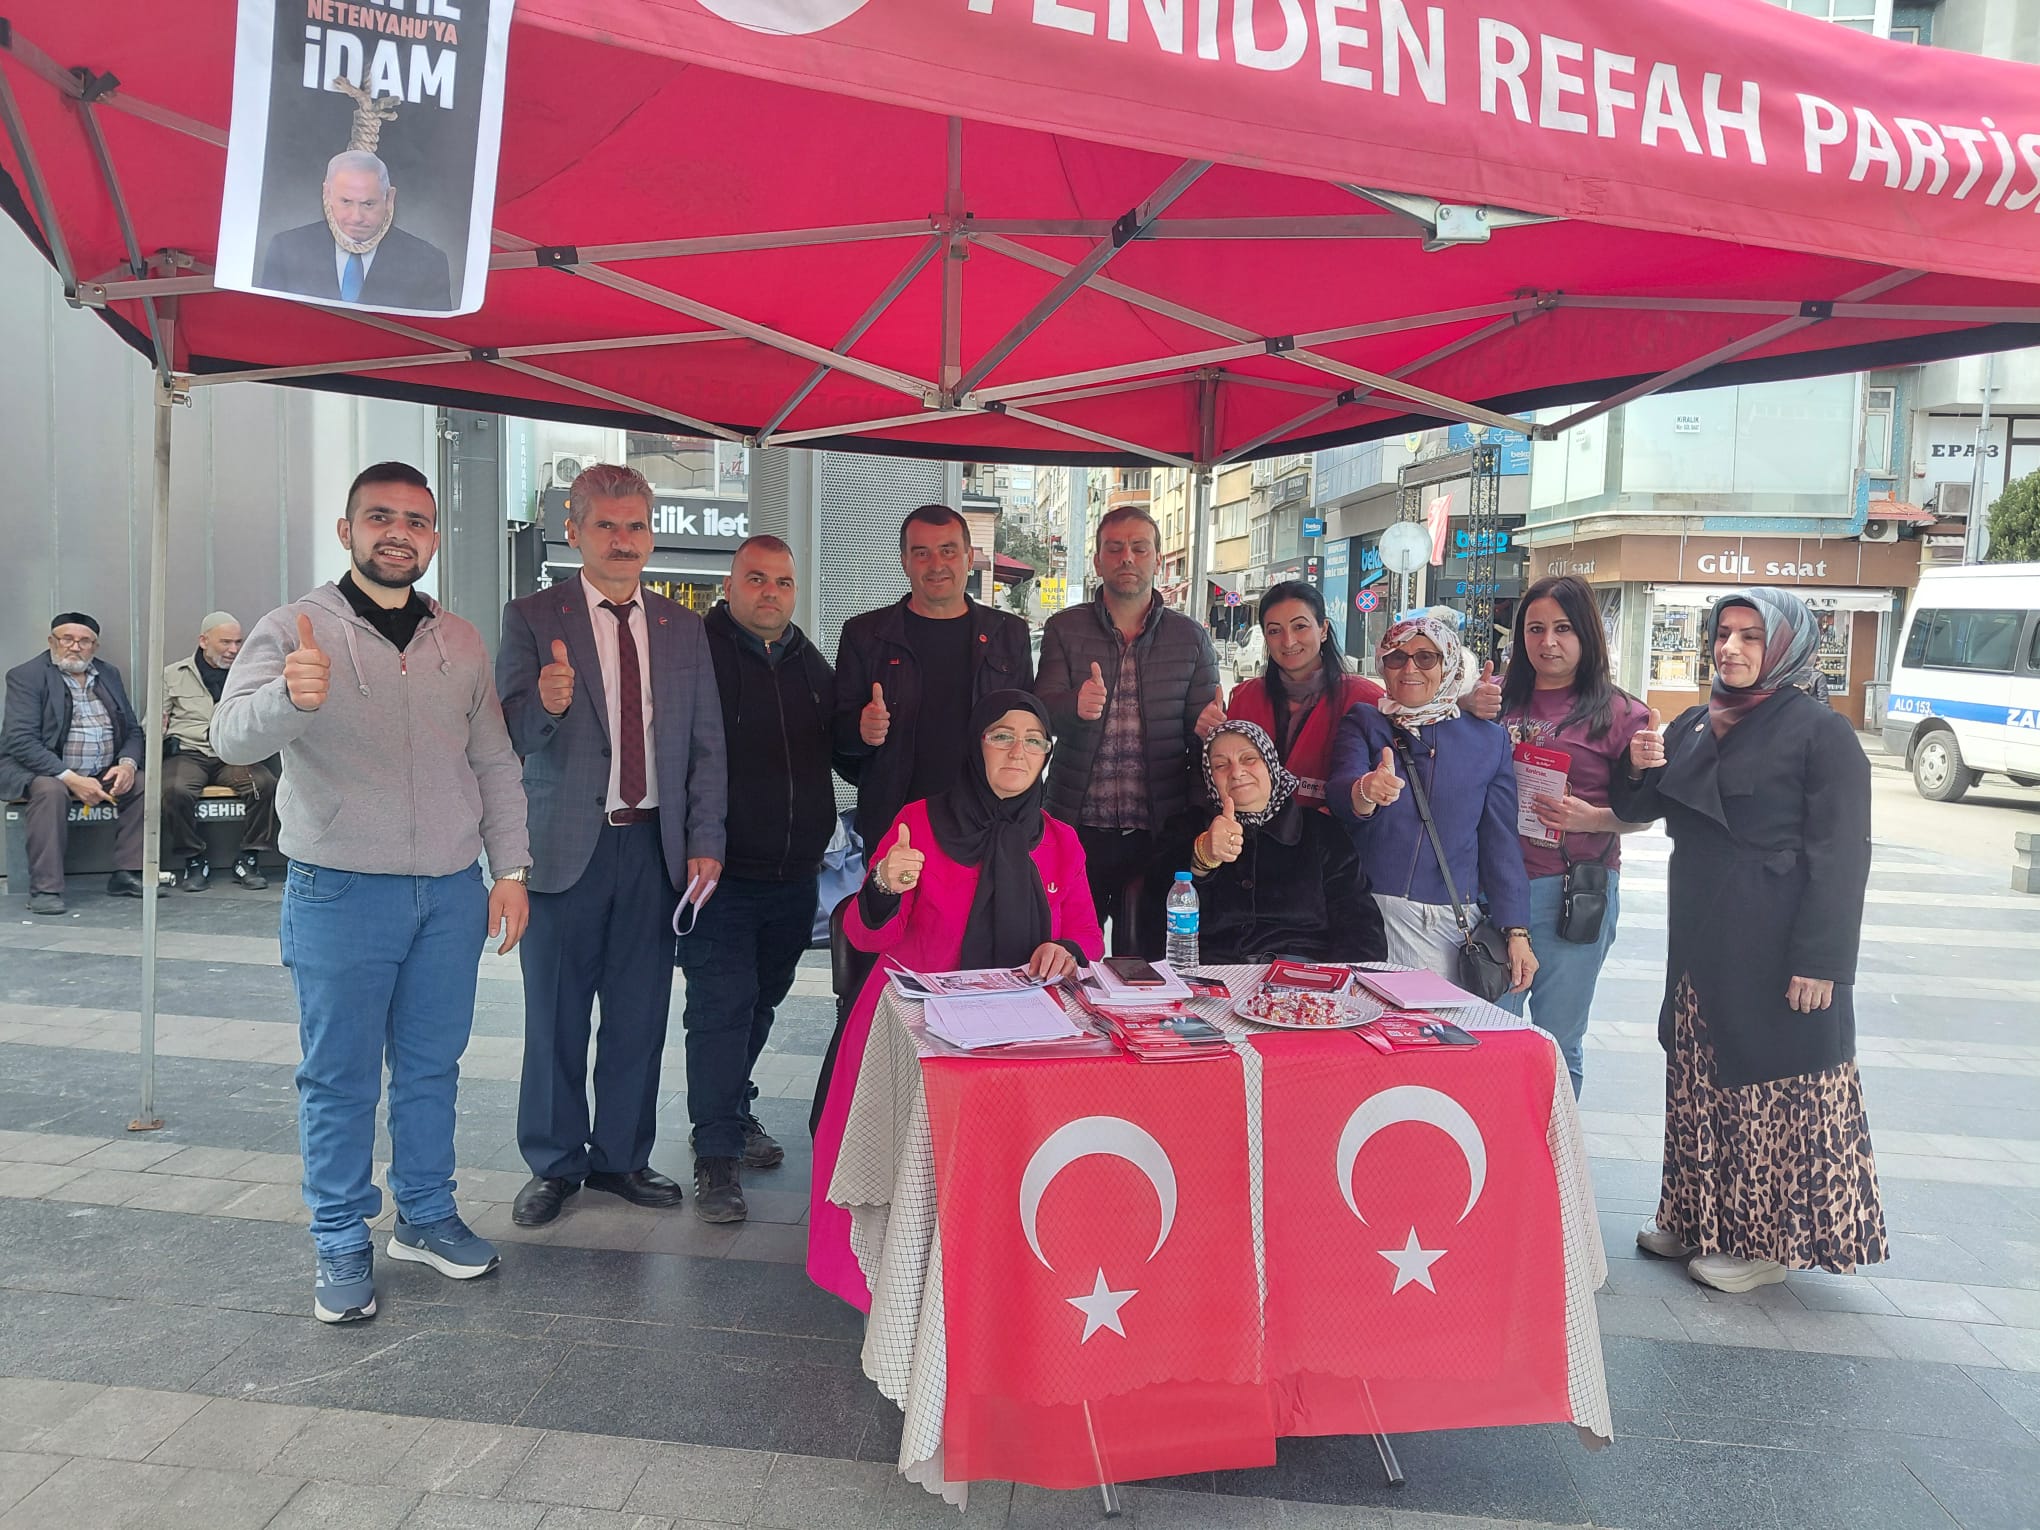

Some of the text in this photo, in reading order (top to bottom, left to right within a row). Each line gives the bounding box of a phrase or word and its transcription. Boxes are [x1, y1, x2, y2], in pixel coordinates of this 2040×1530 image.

[303, 25, 458, 110] İDAM
[1478, 17, 1767, 166] REFAH
[1795, 92, 2040, 214] PARTİS
[651, 505, 749, 538] tlik ilet
[1572, 560, 1596, 576] saat
[1697, 550, 1828, 577] GÜL saat
[1894, 698, 1914, 711] ALO
[194, 803, 247, 818] ŞEHİR
